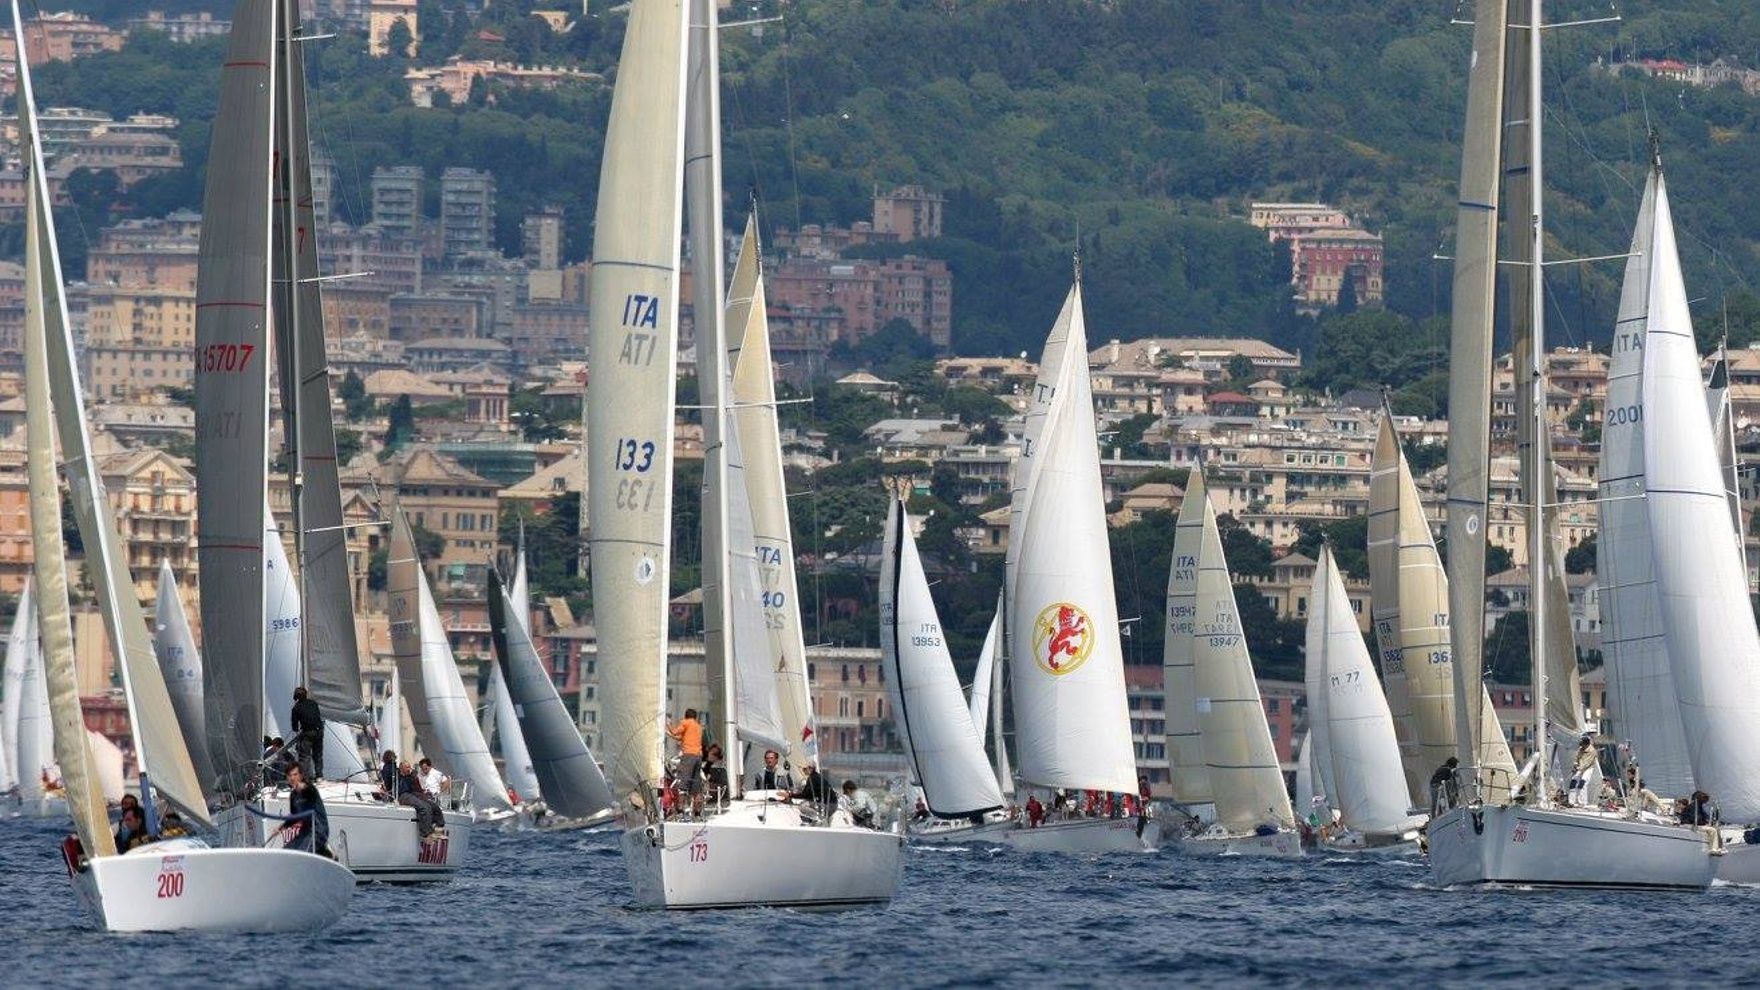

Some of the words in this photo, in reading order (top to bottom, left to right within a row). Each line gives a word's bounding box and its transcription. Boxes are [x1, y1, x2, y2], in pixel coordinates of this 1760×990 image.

[623, 294, 660, 329] ITA
[1617, 332, 1643, 353] ITA
[615, 438, 656, 473] 133
[1177, 555, 1195, 568] ITA
[920, 623, 937, 634] ITA
[1434, 613, 1450, 627] IT
[1209, 636, 1240, 648] 13947
[690, 842, 708, 863] 173
[157, 872, 184, 899] 200
